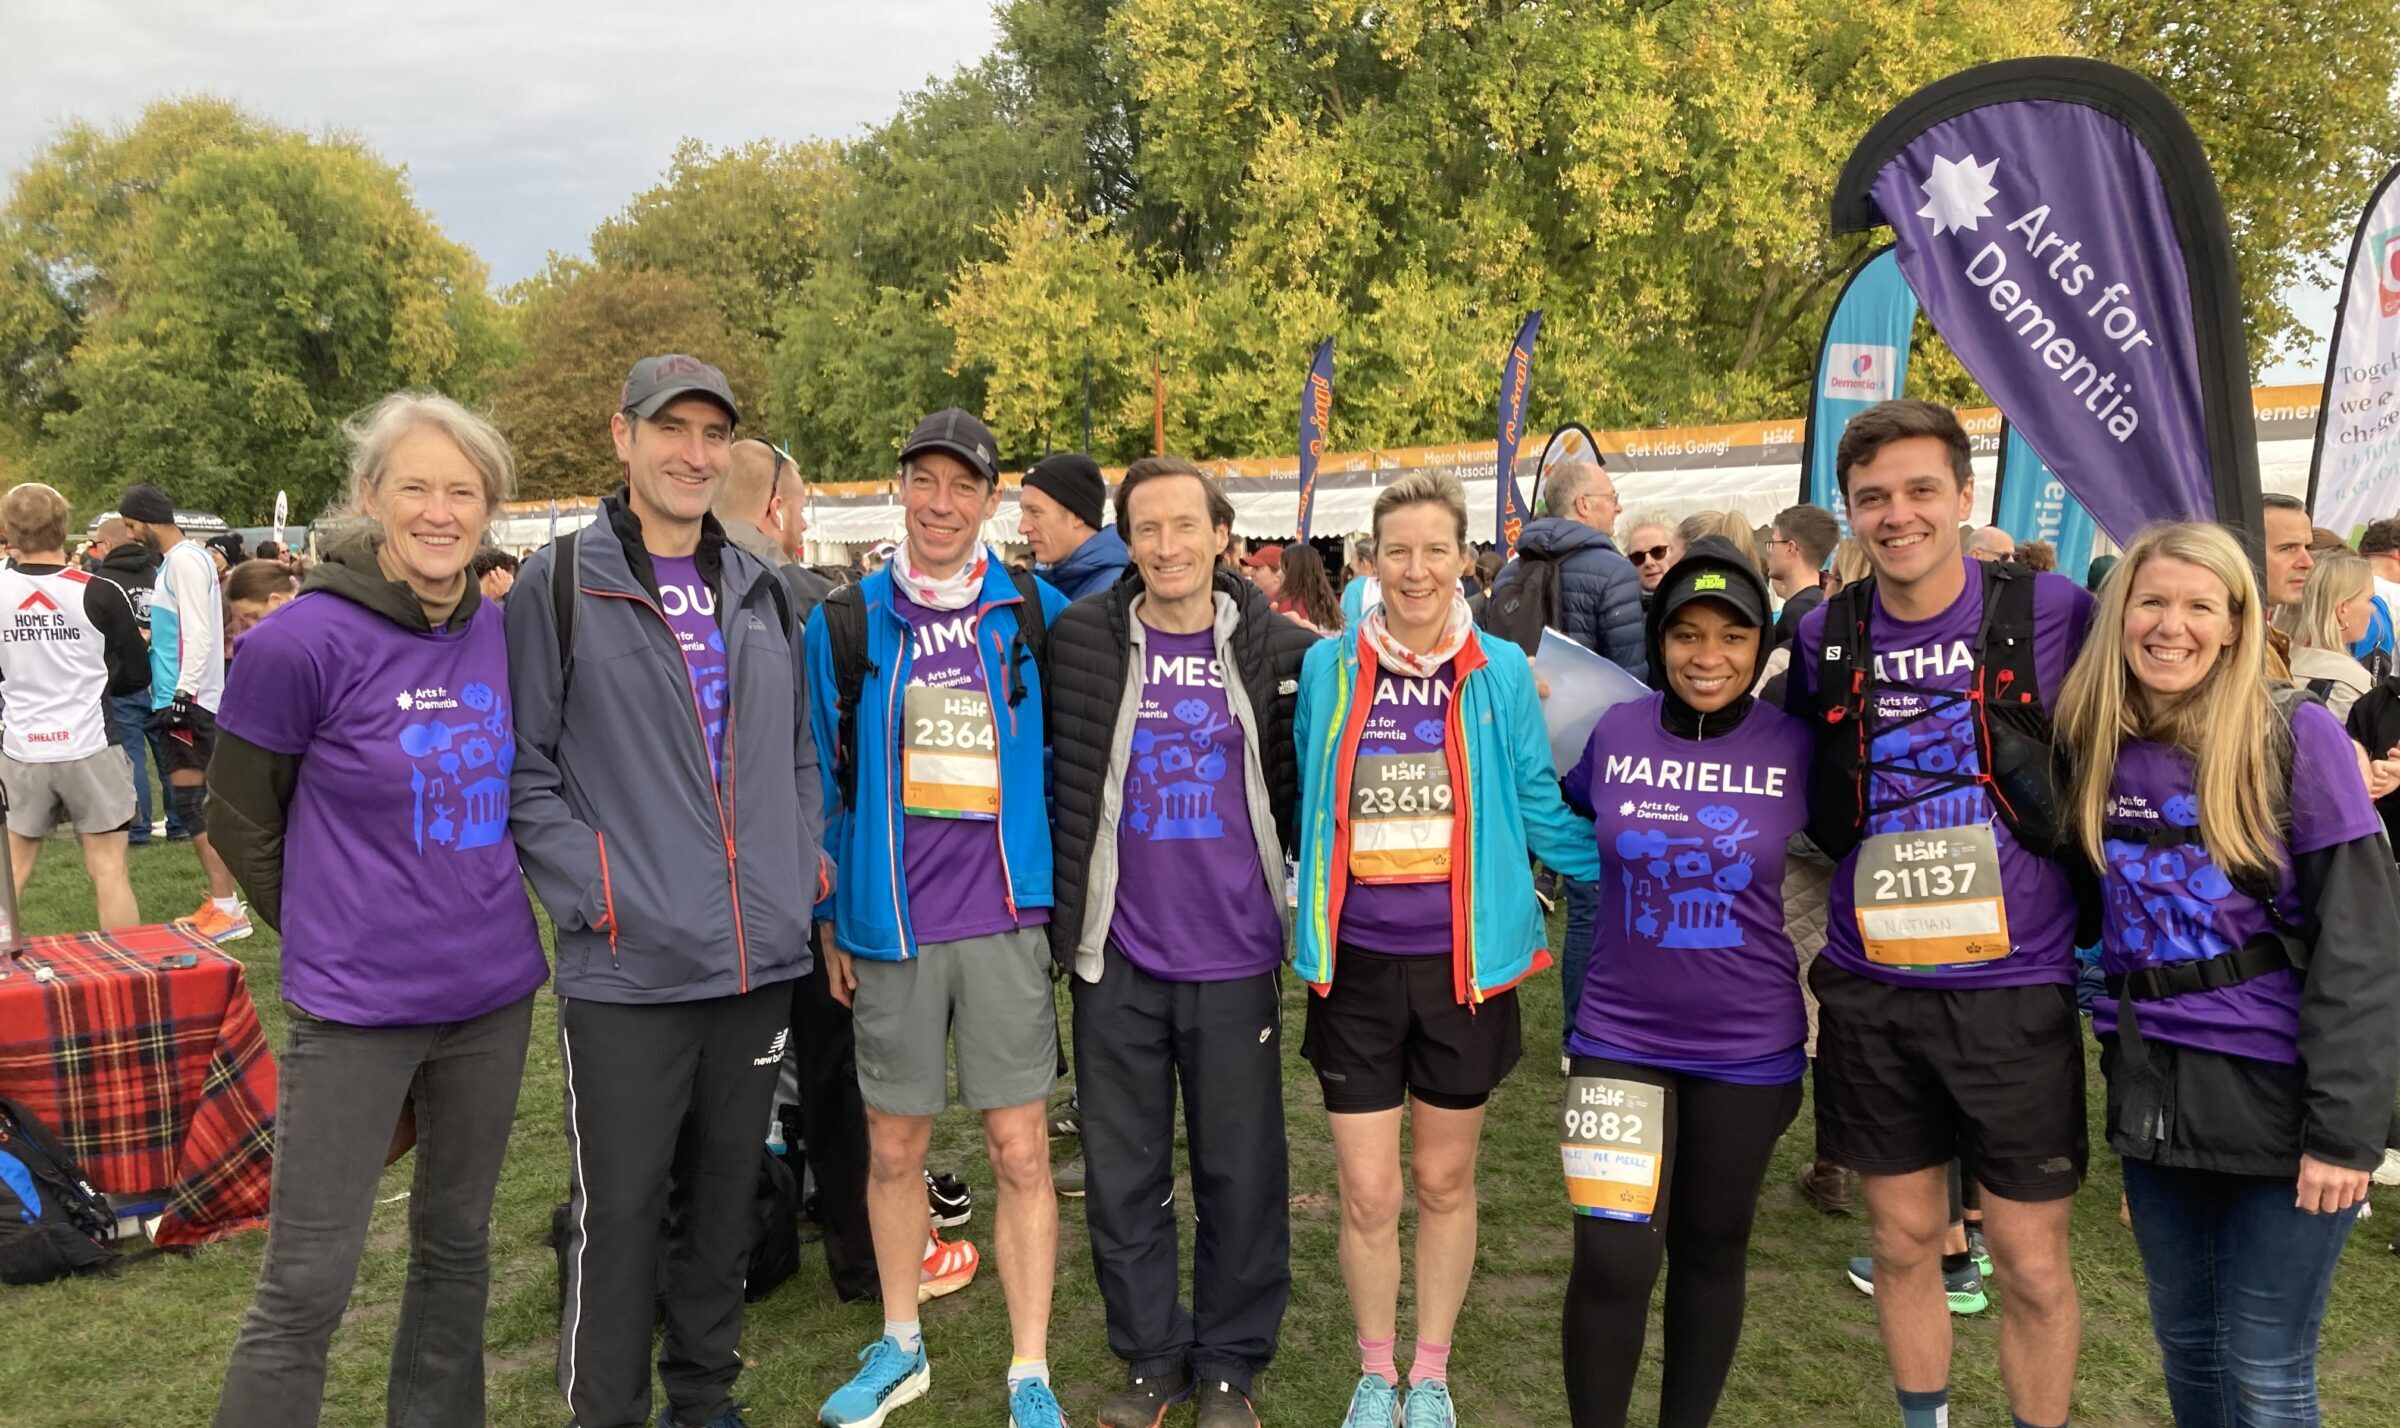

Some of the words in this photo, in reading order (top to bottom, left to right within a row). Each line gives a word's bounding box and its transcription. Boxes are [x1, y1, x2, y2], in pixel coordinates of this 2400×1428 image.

[2006, 204, 2095, 296] Arts
[2087, 282, 2153, 353] for
[1965, 241, 2139, 443] Dementia
[1831, 376, 1876, 390] Dementia
[2340, 397, 2372, 415] we
[1762, 428, 1795, 445] Half
[1625, 442, 1650, 457] Get
[1654, 441, 1683, 456] Kids
[1685, 437, 1730, 456] Going!
[1424, 451, 1456, 465] Motor
[658, 584, 717, 616] OU
[15, 614, 49, 628] HOME
[53, 614, 65, 627] IS
[3, 627, 81, 643] EVERYTHING
[928, 670, 947, 682] Arts
[947, 667, 961, 677] for
[1144, 655, 1224, 688] MES
[415, 688, 438, 699] Arts
[1880, 697, 1901, 706] Arts
[1903, 696, 1919, 705] for
[944, 698, 988, 717] Half
[1145, 700, 1160, 709] for
[1378, 717, 1397, 728] for
[27, 730, 70, 742] SHELTER
[914, 718, 996, 751] 2364
[1381, 764, 1426, 782] Half
[1605, 755, 1787, 798] MARIELLE
[1358, 784, 1454, 814] 23619
[1639, 800, 1663, 811] Arts
[1664, 802, 1681, 812] for
[2132, 796, 2148, 807] for
[1636, 809, 1689, 822] Dementia
[1894, 840, 1948, 862] Half
[1872, 862, 1978, 901] 21137
[753, 1057, 773, 1066] new
[1581, 1087, 1625, 1107] Half
[1564, 1109, 1643, 1145] 9882
